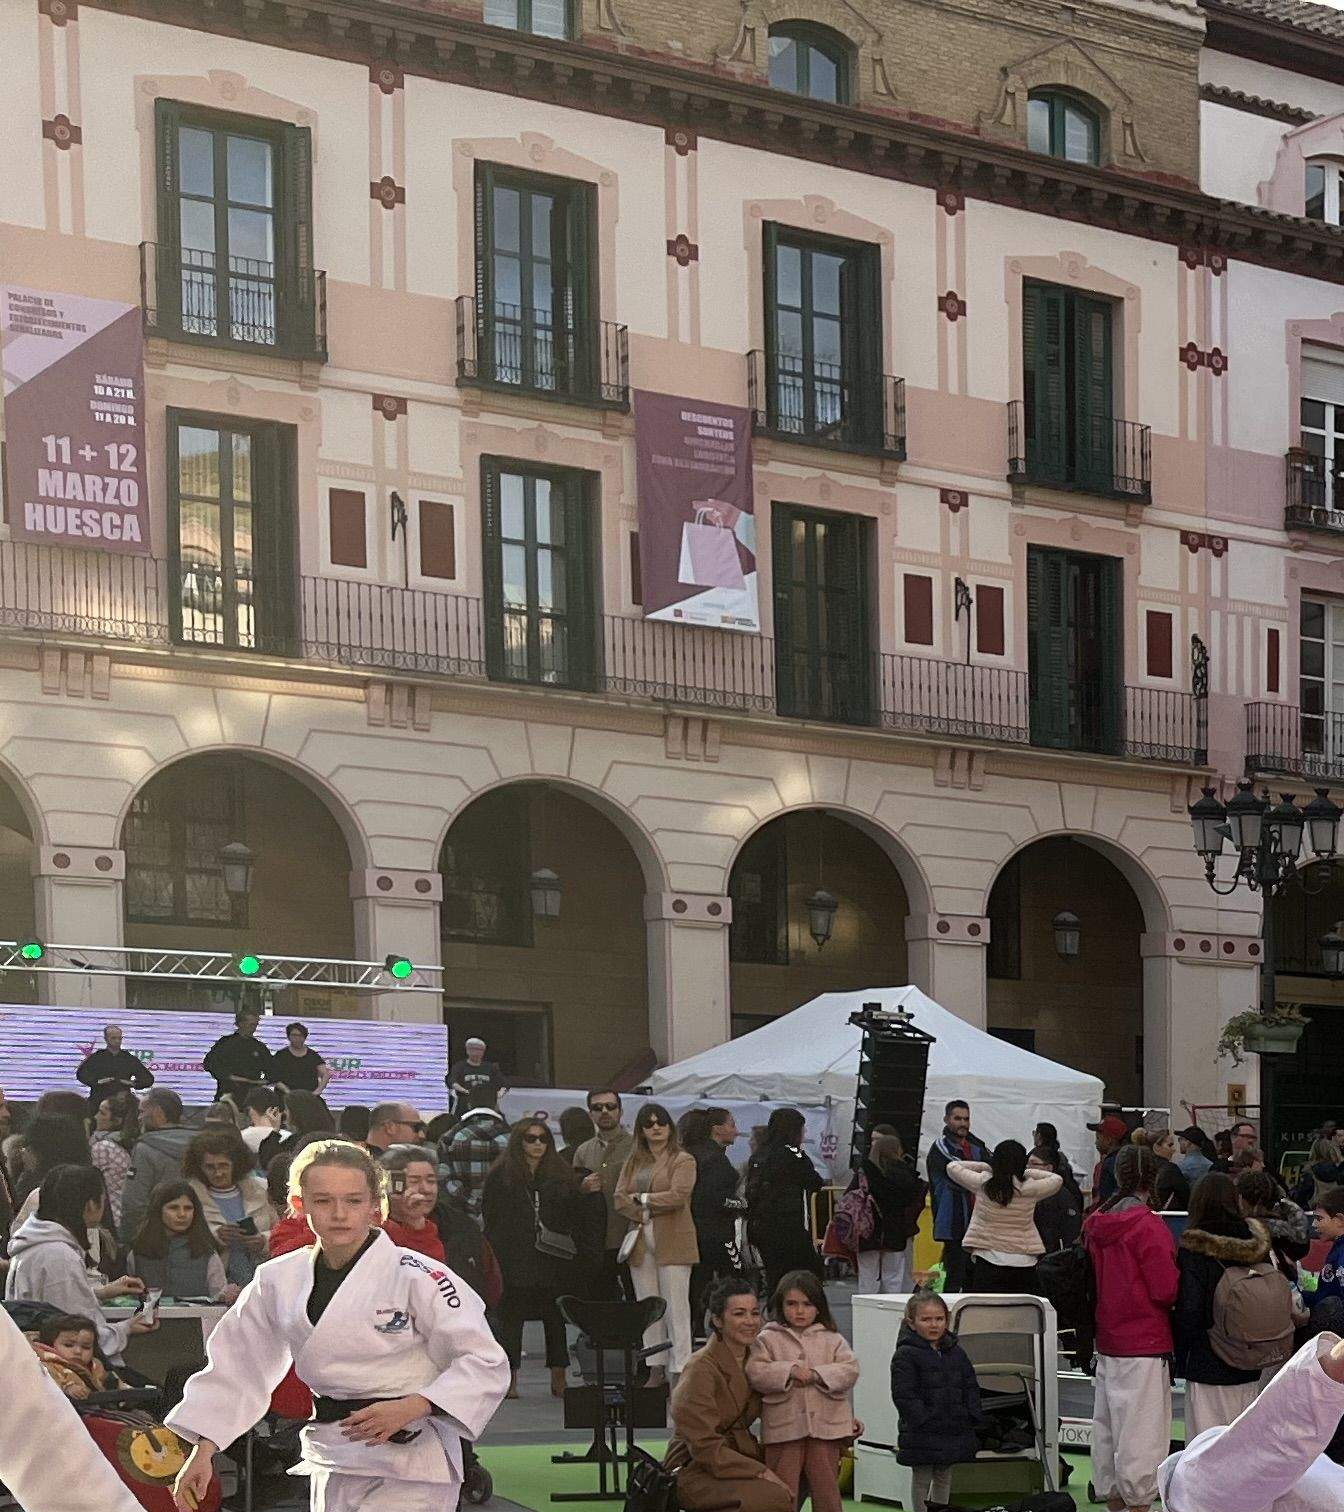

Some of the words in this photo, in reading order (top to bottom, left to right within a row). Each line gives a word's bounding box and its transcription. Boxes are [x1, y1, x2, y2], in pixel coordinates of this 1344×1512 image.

[42, 434, 71, 464] 11
[104, 443, 137, 472] 12
[38, 468, 138, 507] MARZO
[25, 502, 141, 542] HUESCA
[1281, 1132, 1314, 1142] KIPS
[1061, 1428, 1092, 1443] TOKY
